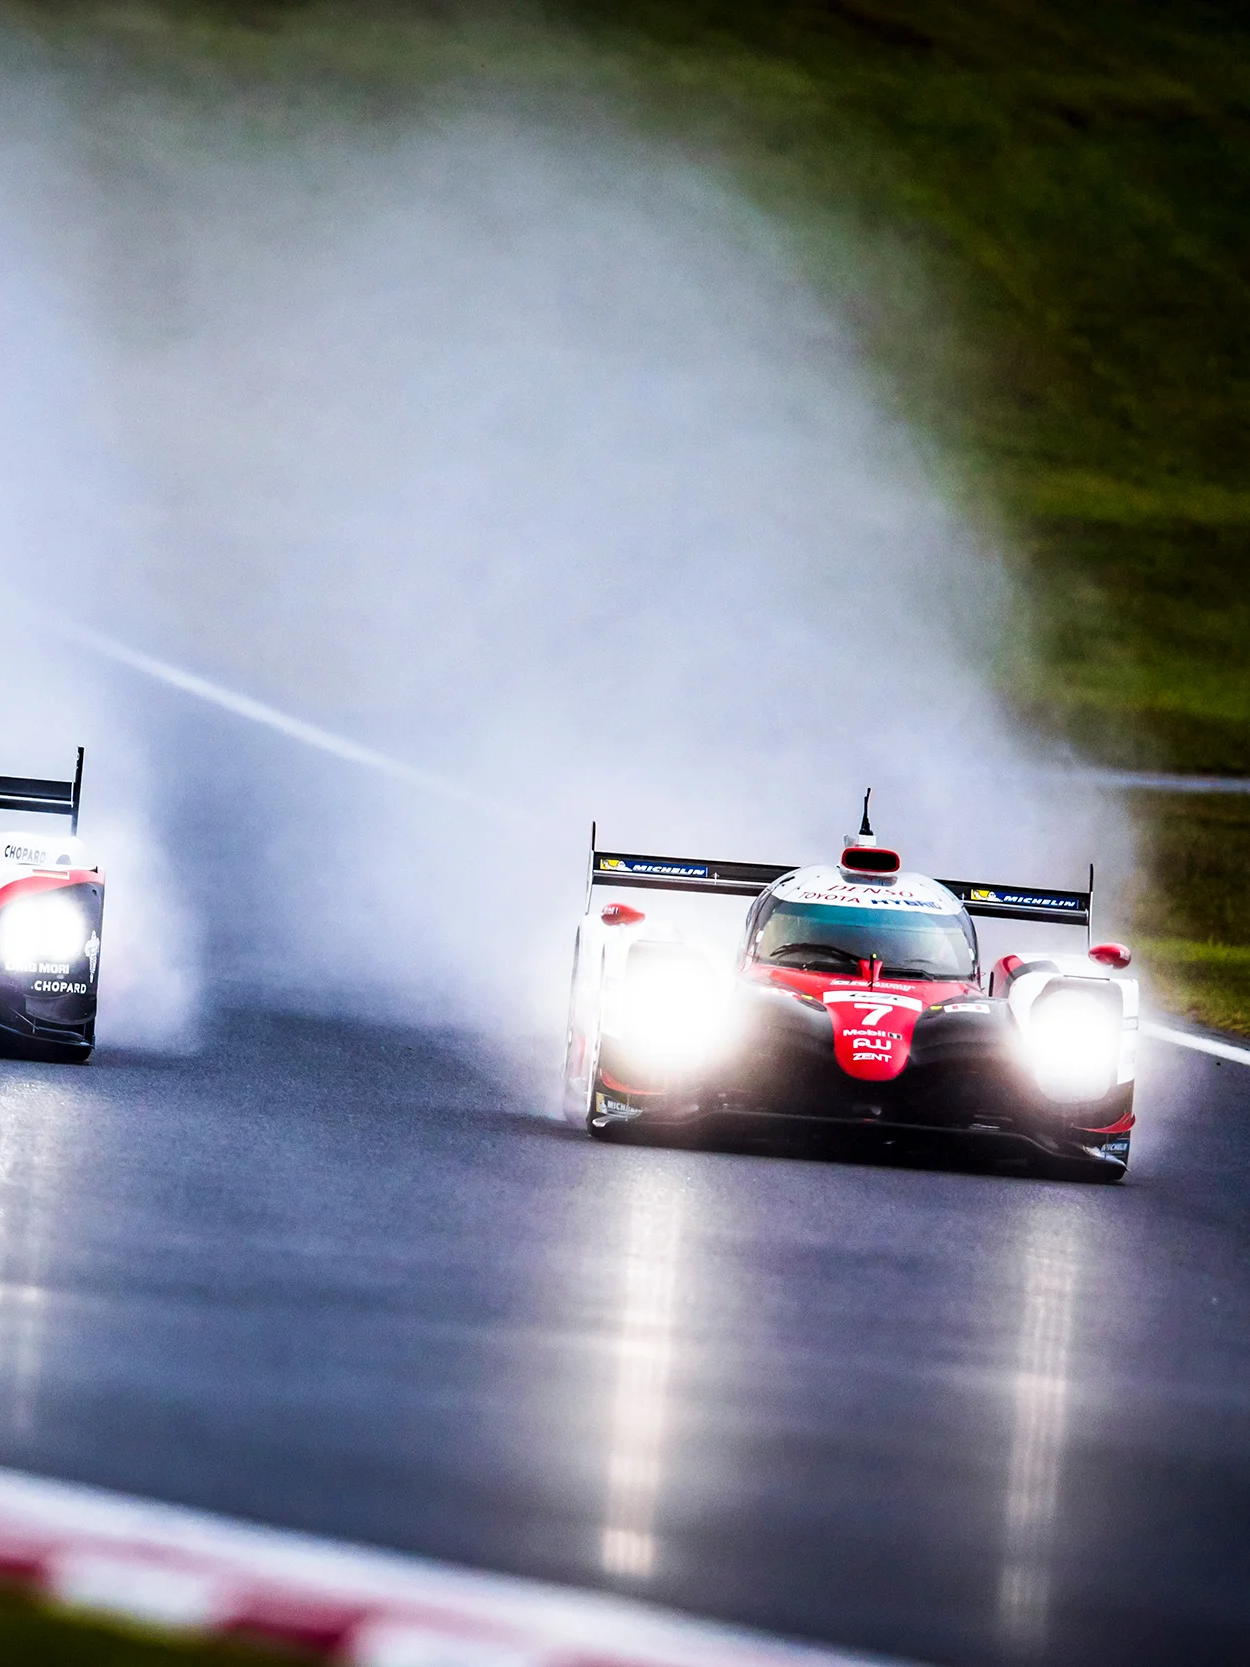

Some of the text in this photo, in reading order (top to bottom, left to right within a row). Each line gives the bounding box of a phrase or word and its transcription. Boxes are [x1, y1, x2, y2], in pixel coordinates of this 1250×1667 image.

[4, 845, 46, 863] CHOPARD
[633, 864, 705, 875] MICHELIN
[828, 885, 913, 897] DENSO
[800, 891, 860, 904] TOYOTA
[1003, 895, 1075, 907] MICHELIN
[39, 963, 69, 974] MORI
[34, 980, 87, 994] CHOPARD
[854, 1003, 893, 1026] 7
[843, 1029, 886, 1037] Mobil
[853, 1052, 892, 1062] ZENT
